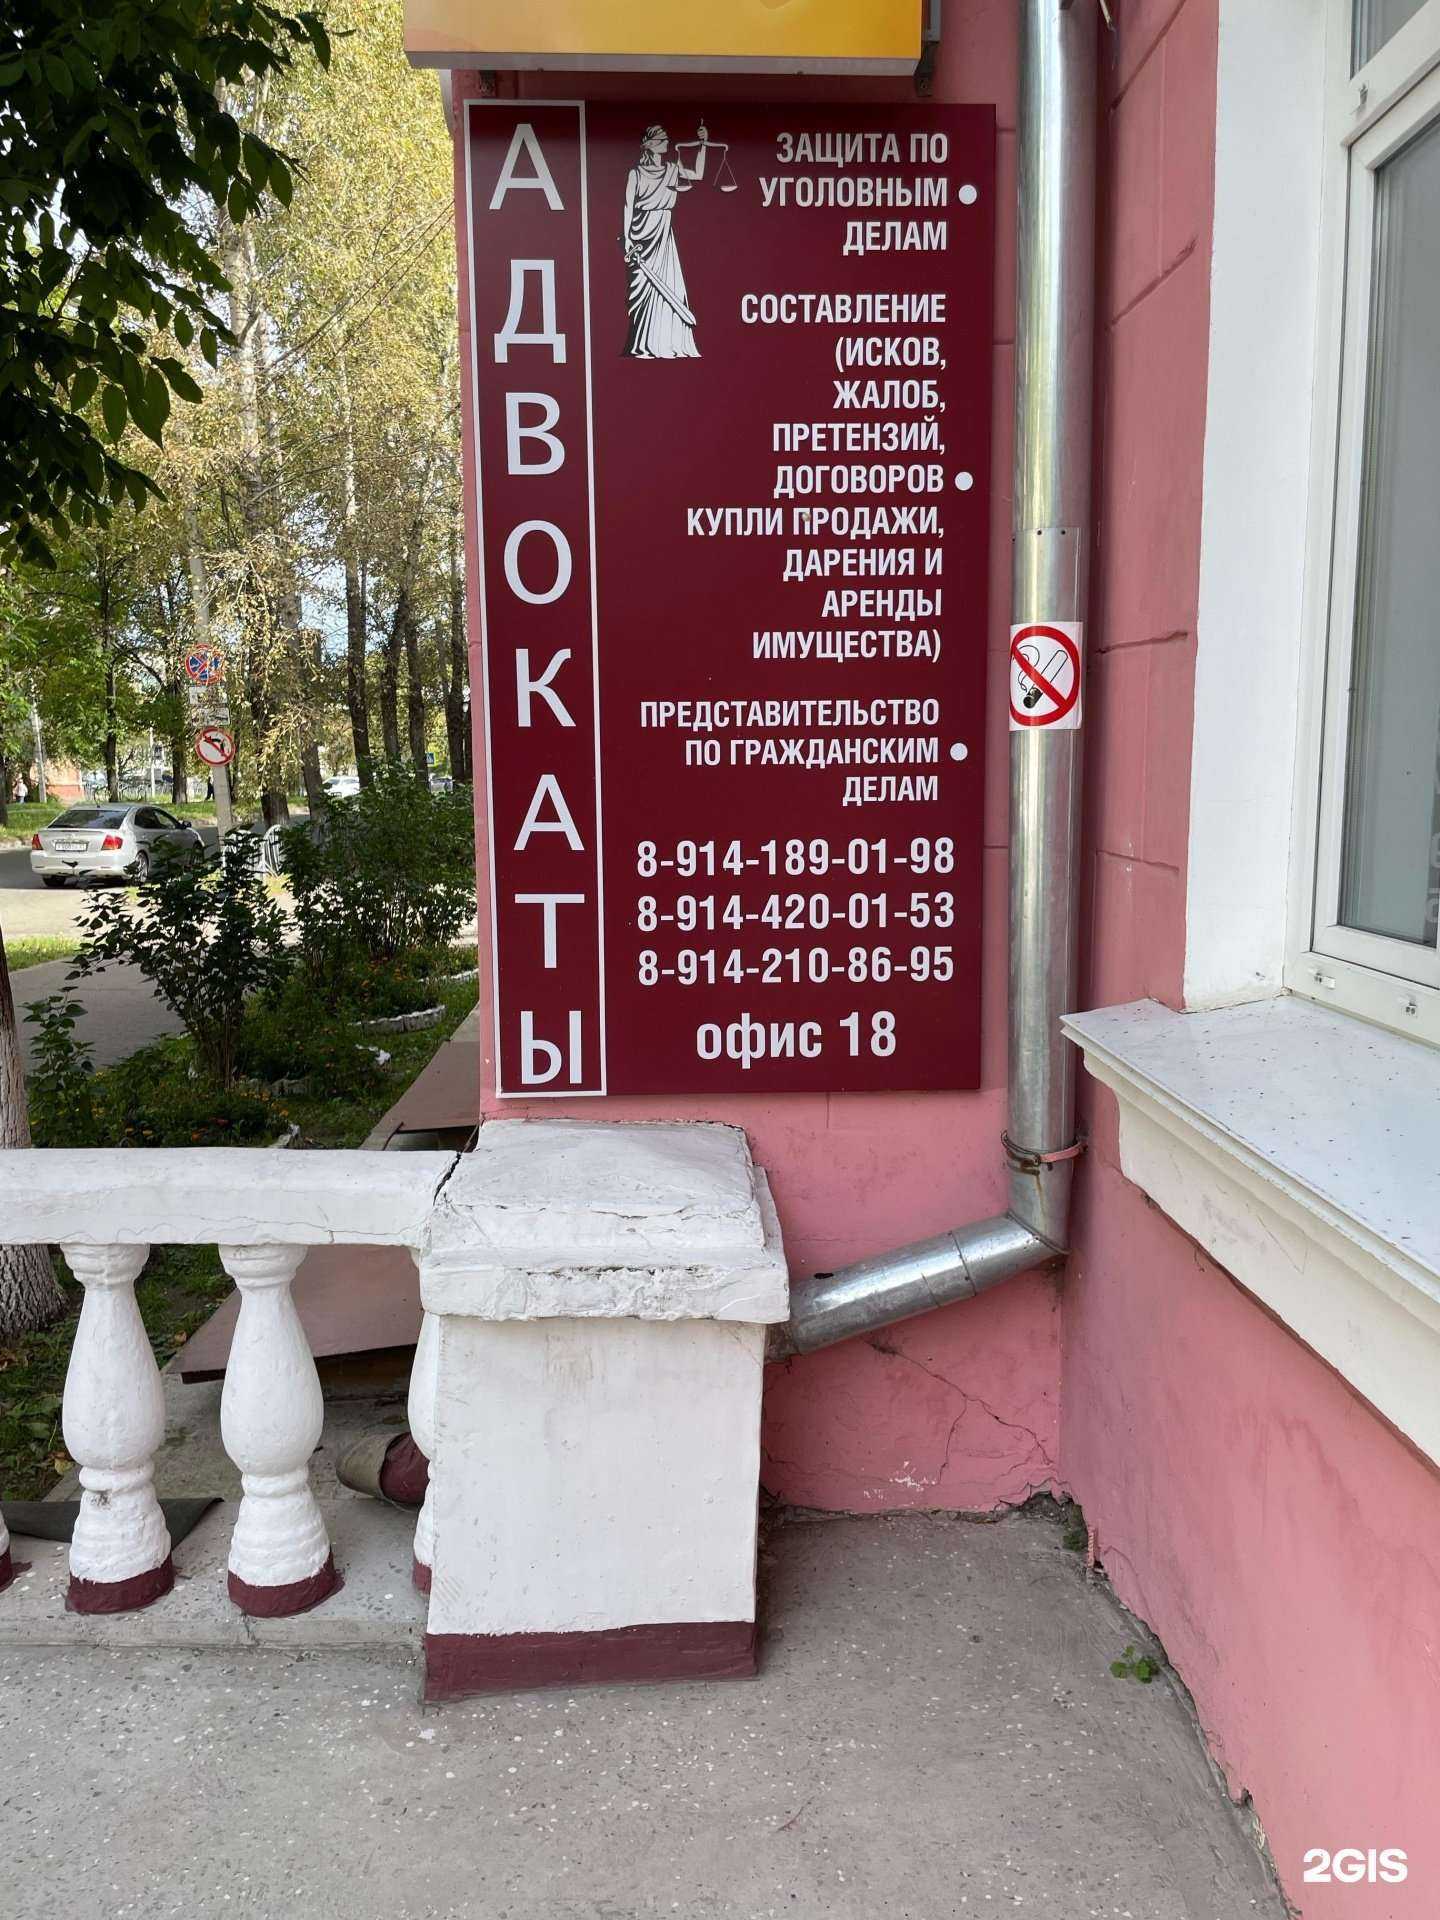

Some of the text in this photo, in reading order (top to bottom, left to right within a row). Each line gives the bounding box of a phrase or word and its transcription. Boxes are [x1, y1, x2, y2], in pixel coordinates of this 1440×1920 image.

[776, 132, 948, 167] ЗАЩИТА ПО
[758, 176, 948, 208] УГОЛОВНЫМ
[842, 221, 947, 256] ДЕЛАМ
[741, 293, 946, 324] СОСТАВЛЕНИЕ
[835, 336, 946, 373] (ИСКОВ,
[832, 379, 946, 413] ЖАЛОБ,
[773, 414, 945, 455] ПРЕТЕНЗИЙ,
[773, 464, 944, 499] ДОГОВОРОВ
[687, 506, 944, 541] КУПЛИ ПРОДАЖИ,
[782, 547, 943, 582] ДАРЕНИЯ И
[488, 123, 585, 1085] АДВОКАТЫ
[821, 588, 942, 622] АРЕНДЫ
[752, 628, 941, 664] ИМУЩЕСТВА)
[640, 698, 939, 732] ПРЕДСТАВИТЕЛЬСТВО
[685, 737, 939, 770] ПО ГРАЖДАНСКИМ
[842, 775, 938, 807] ДЕЛАМ
[637, 836, 954, 878] 8-914-189-01-98
[637, 891, 954, 932] 8-914-420-01-53
[638, 945, 954, 986] 8-914-210-86-95
[696, 1010, 897, 1070] офис 18
